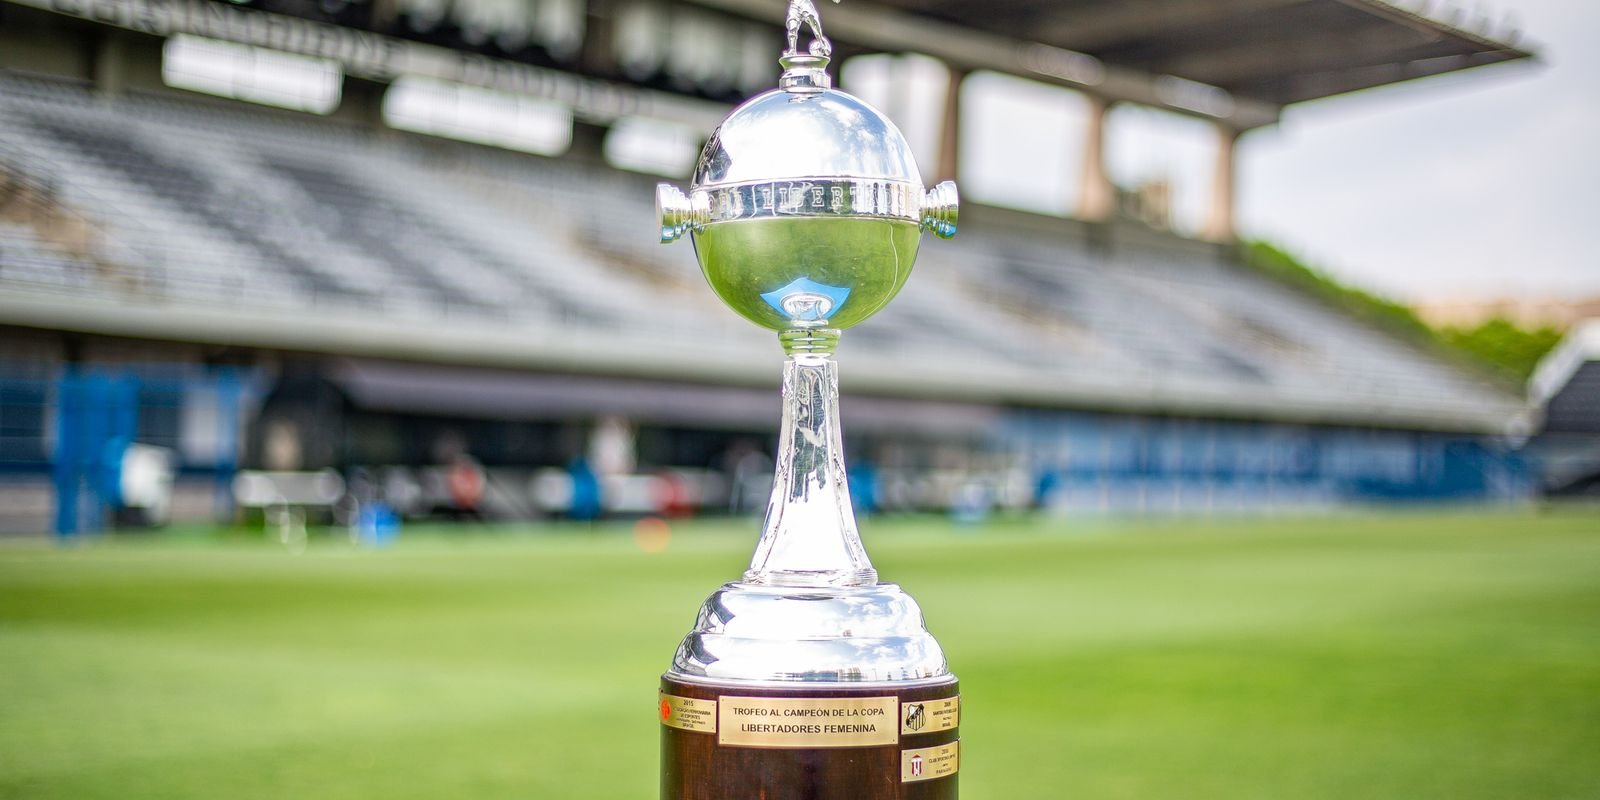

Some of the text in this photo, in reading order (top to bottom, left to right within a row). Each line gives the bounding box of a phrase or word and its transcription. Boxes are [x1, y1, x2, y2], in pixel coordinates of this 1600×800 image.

[733, 707, 885, 717] TROFEO AL CAMPEÓN DE LA COPA
[741, 723, 877, 733] LIBERTADORES FEMENINA
